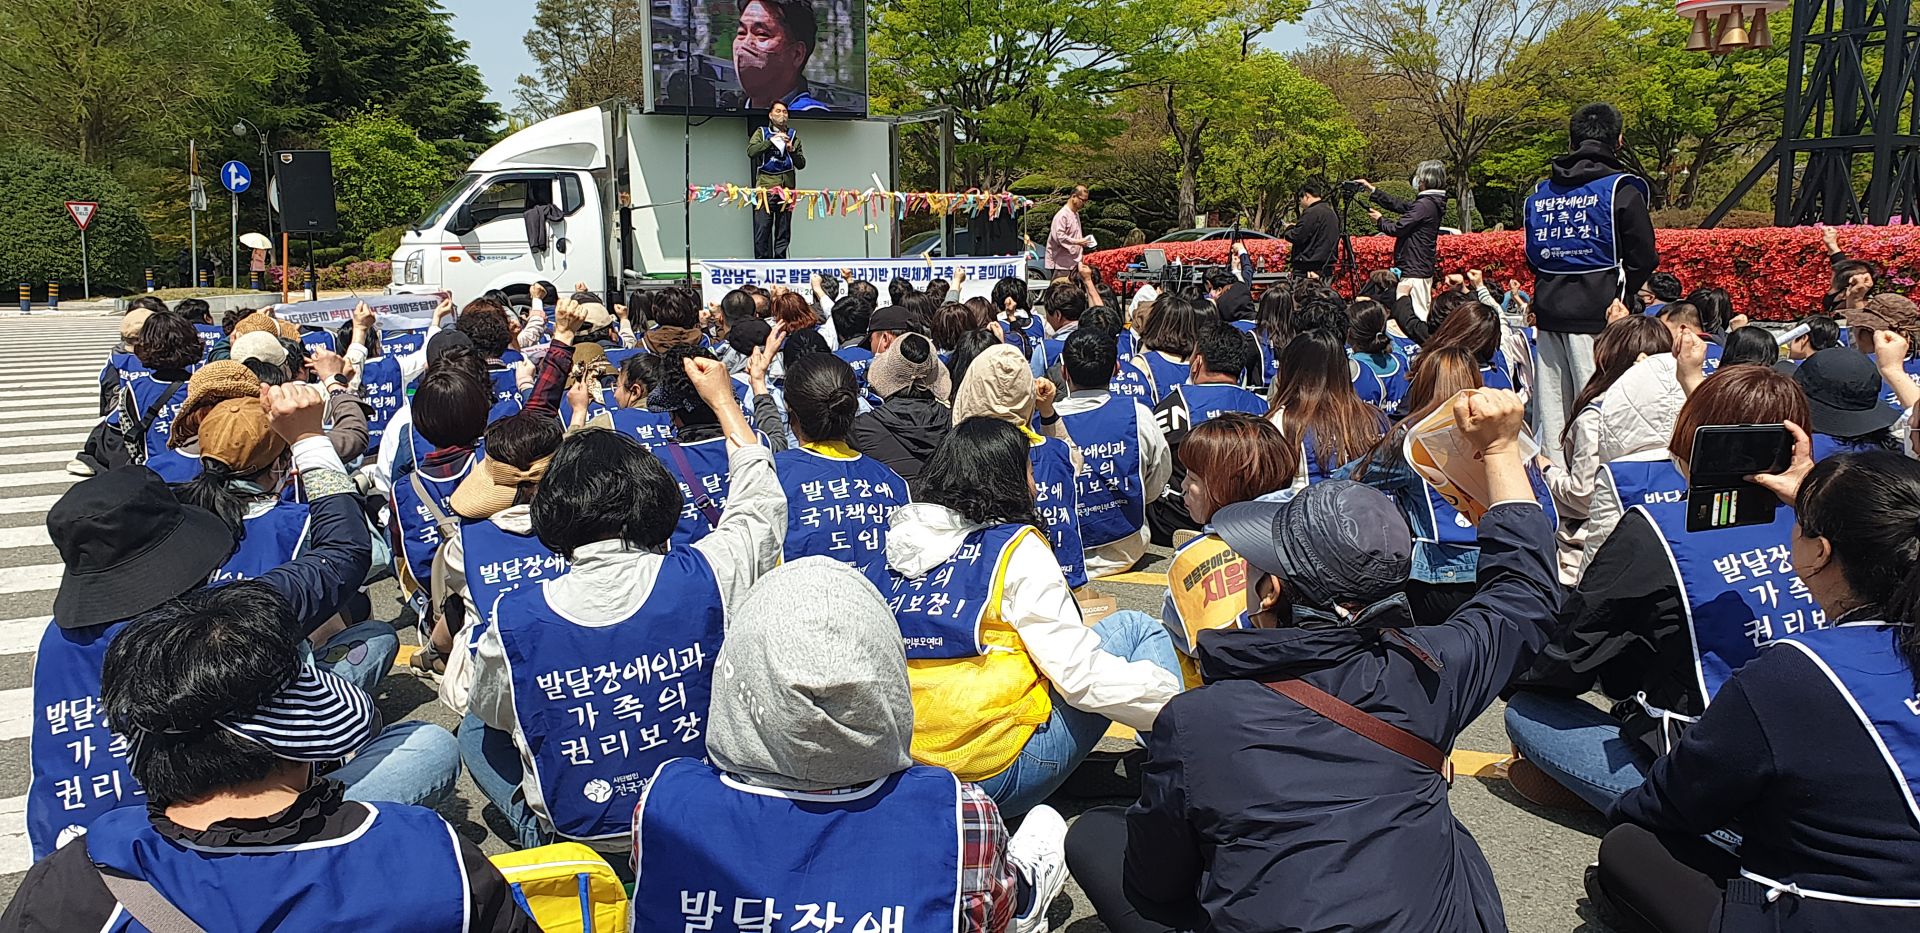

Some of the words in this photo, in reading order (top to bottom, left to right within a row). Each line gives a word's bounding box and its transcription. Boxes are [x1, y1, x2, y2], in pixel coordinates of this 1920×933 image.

[1535, 194, 1598, 212] 발달장애인과
[711, 268, 760, 286] 경상남도,
[764, 269, 787, 284] 시군
[934, 265, 954, 280] 구축
[979, 264, 1017, 280] 결의대회
[801, 478, 894, 502] 발달장애
[1201, 559, 1249, 608] 지원
[536, 643, 706, 701] 발달장애인과
